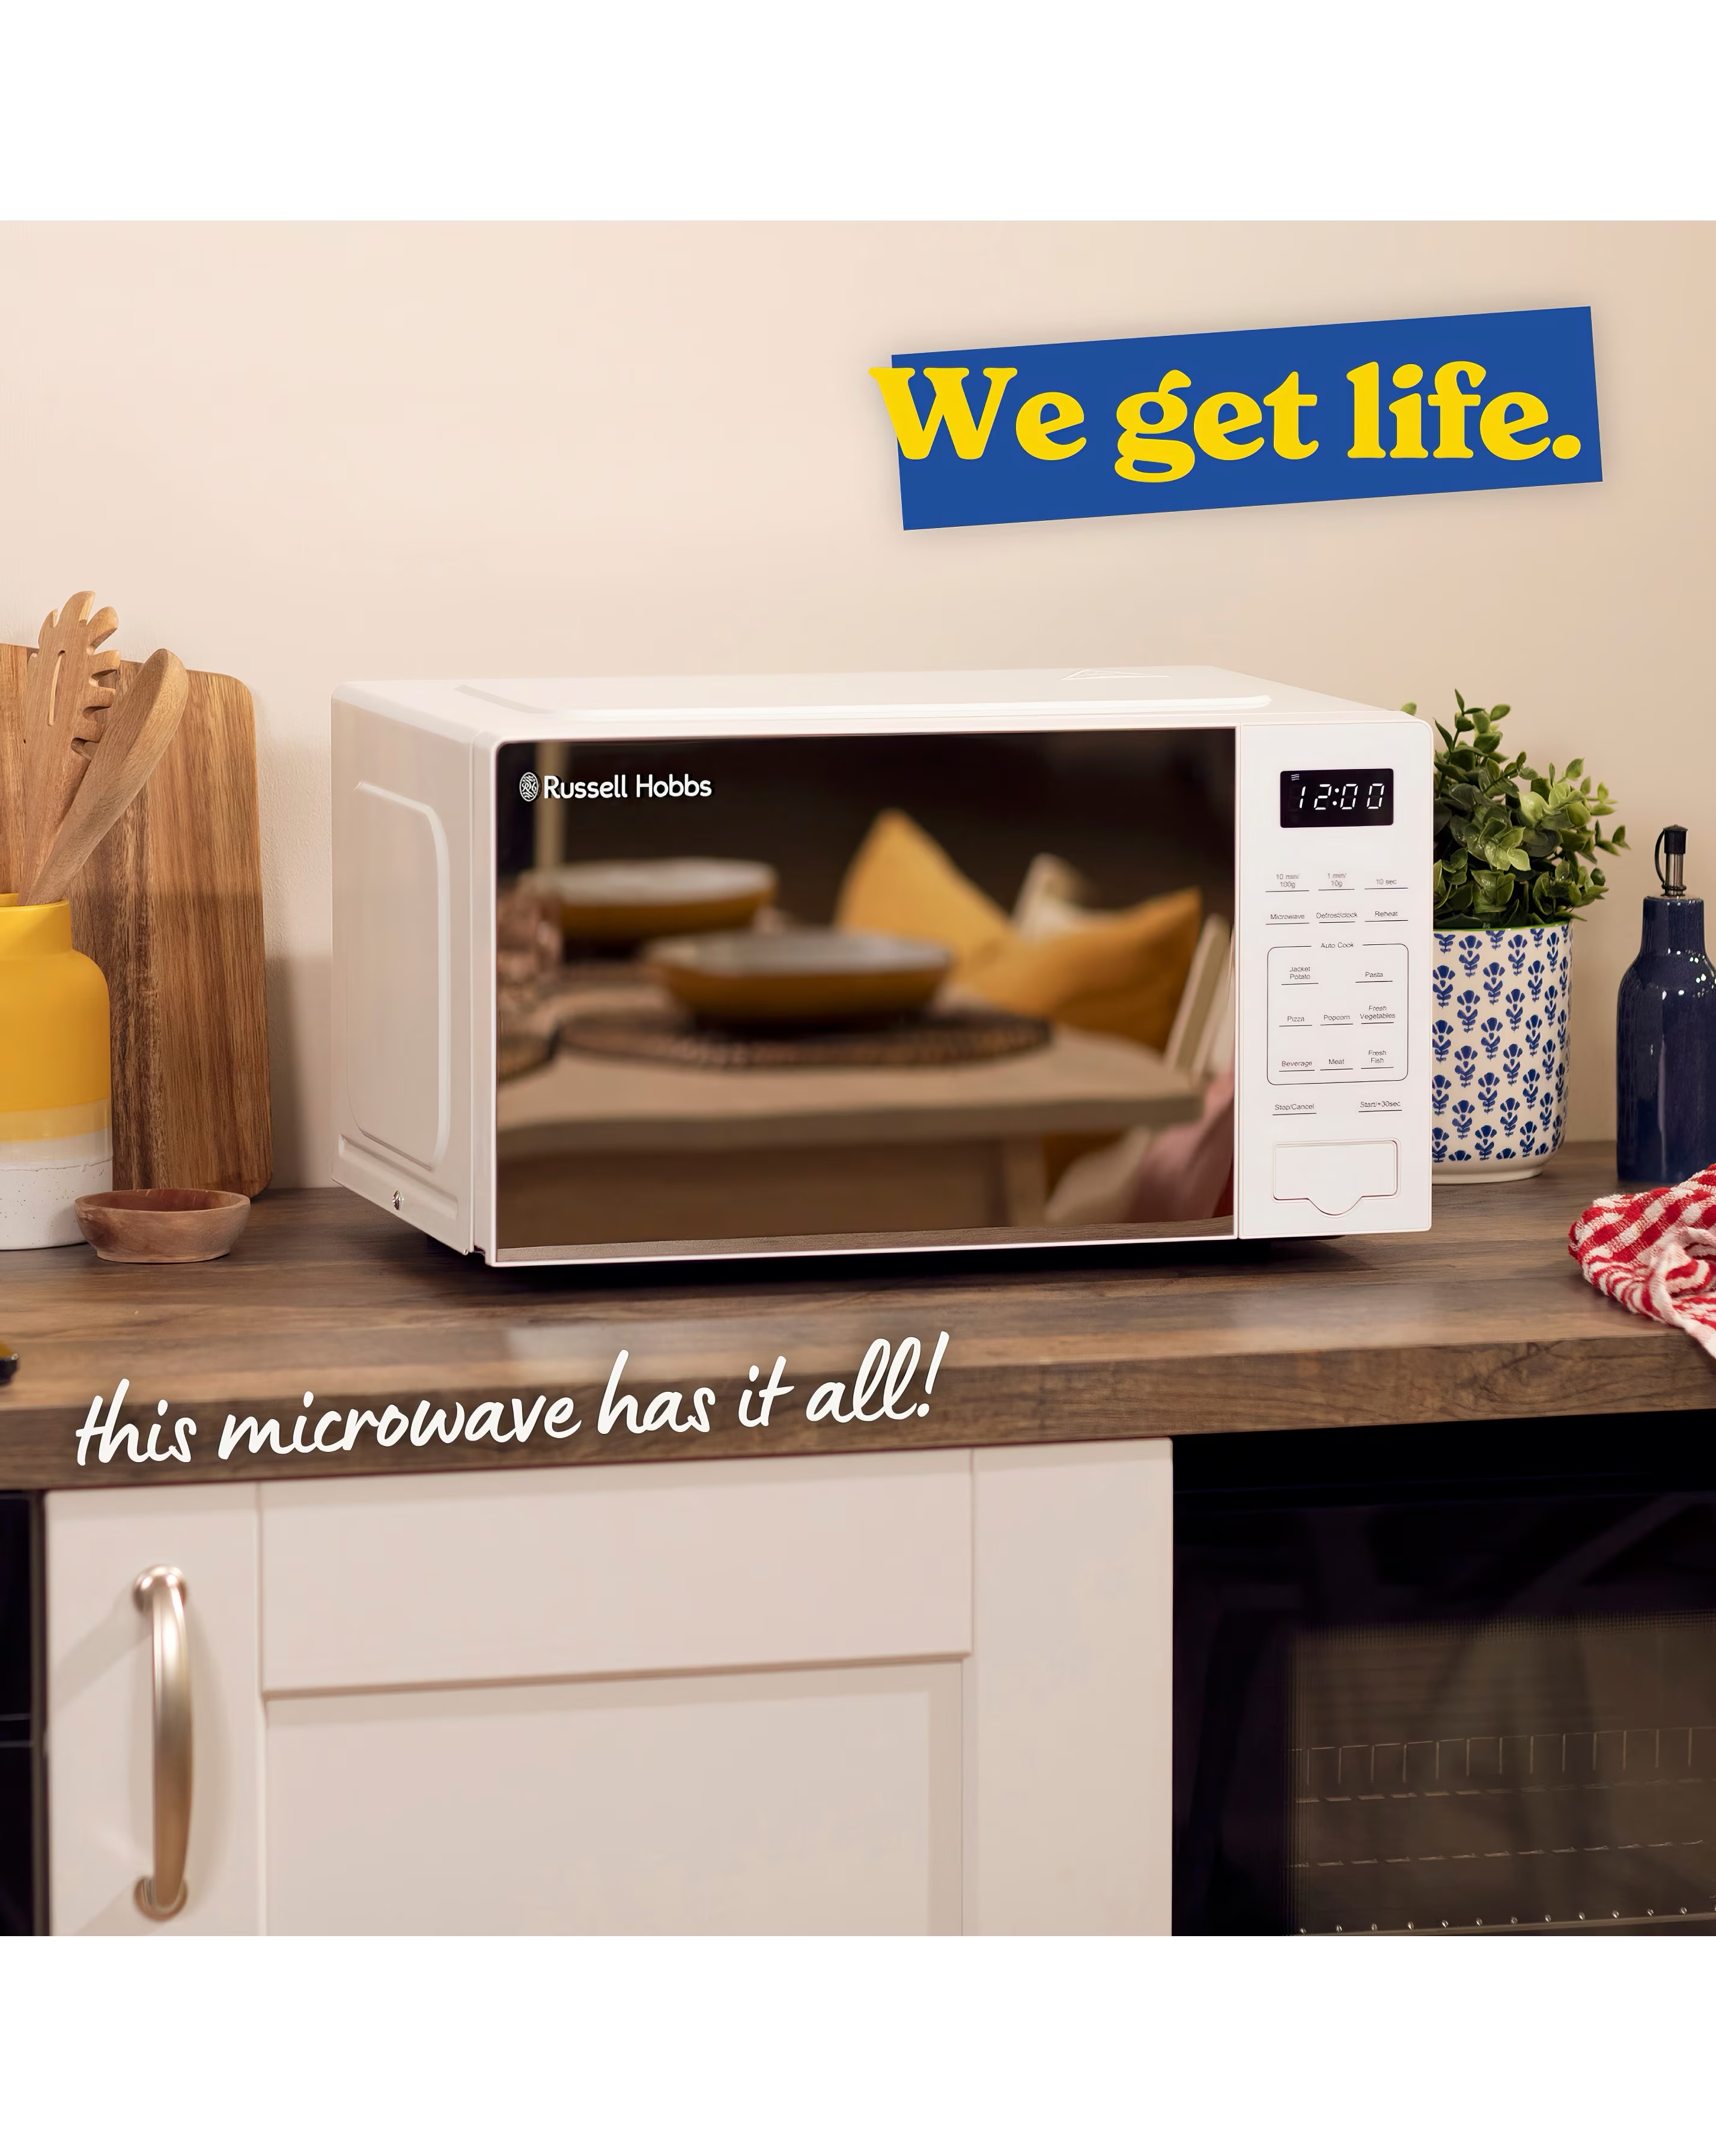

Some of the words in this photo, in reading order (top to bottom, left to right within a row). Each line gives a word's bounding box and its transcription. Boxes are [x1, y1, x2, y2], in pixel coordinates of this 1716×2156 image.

[544, 774, 628, 799] Russell
[636, 773, 712, 798] Hobbs
[1299, 783, 1385, 810] 12:00
[1360, 1012, 1396, 1021] Vegetables
